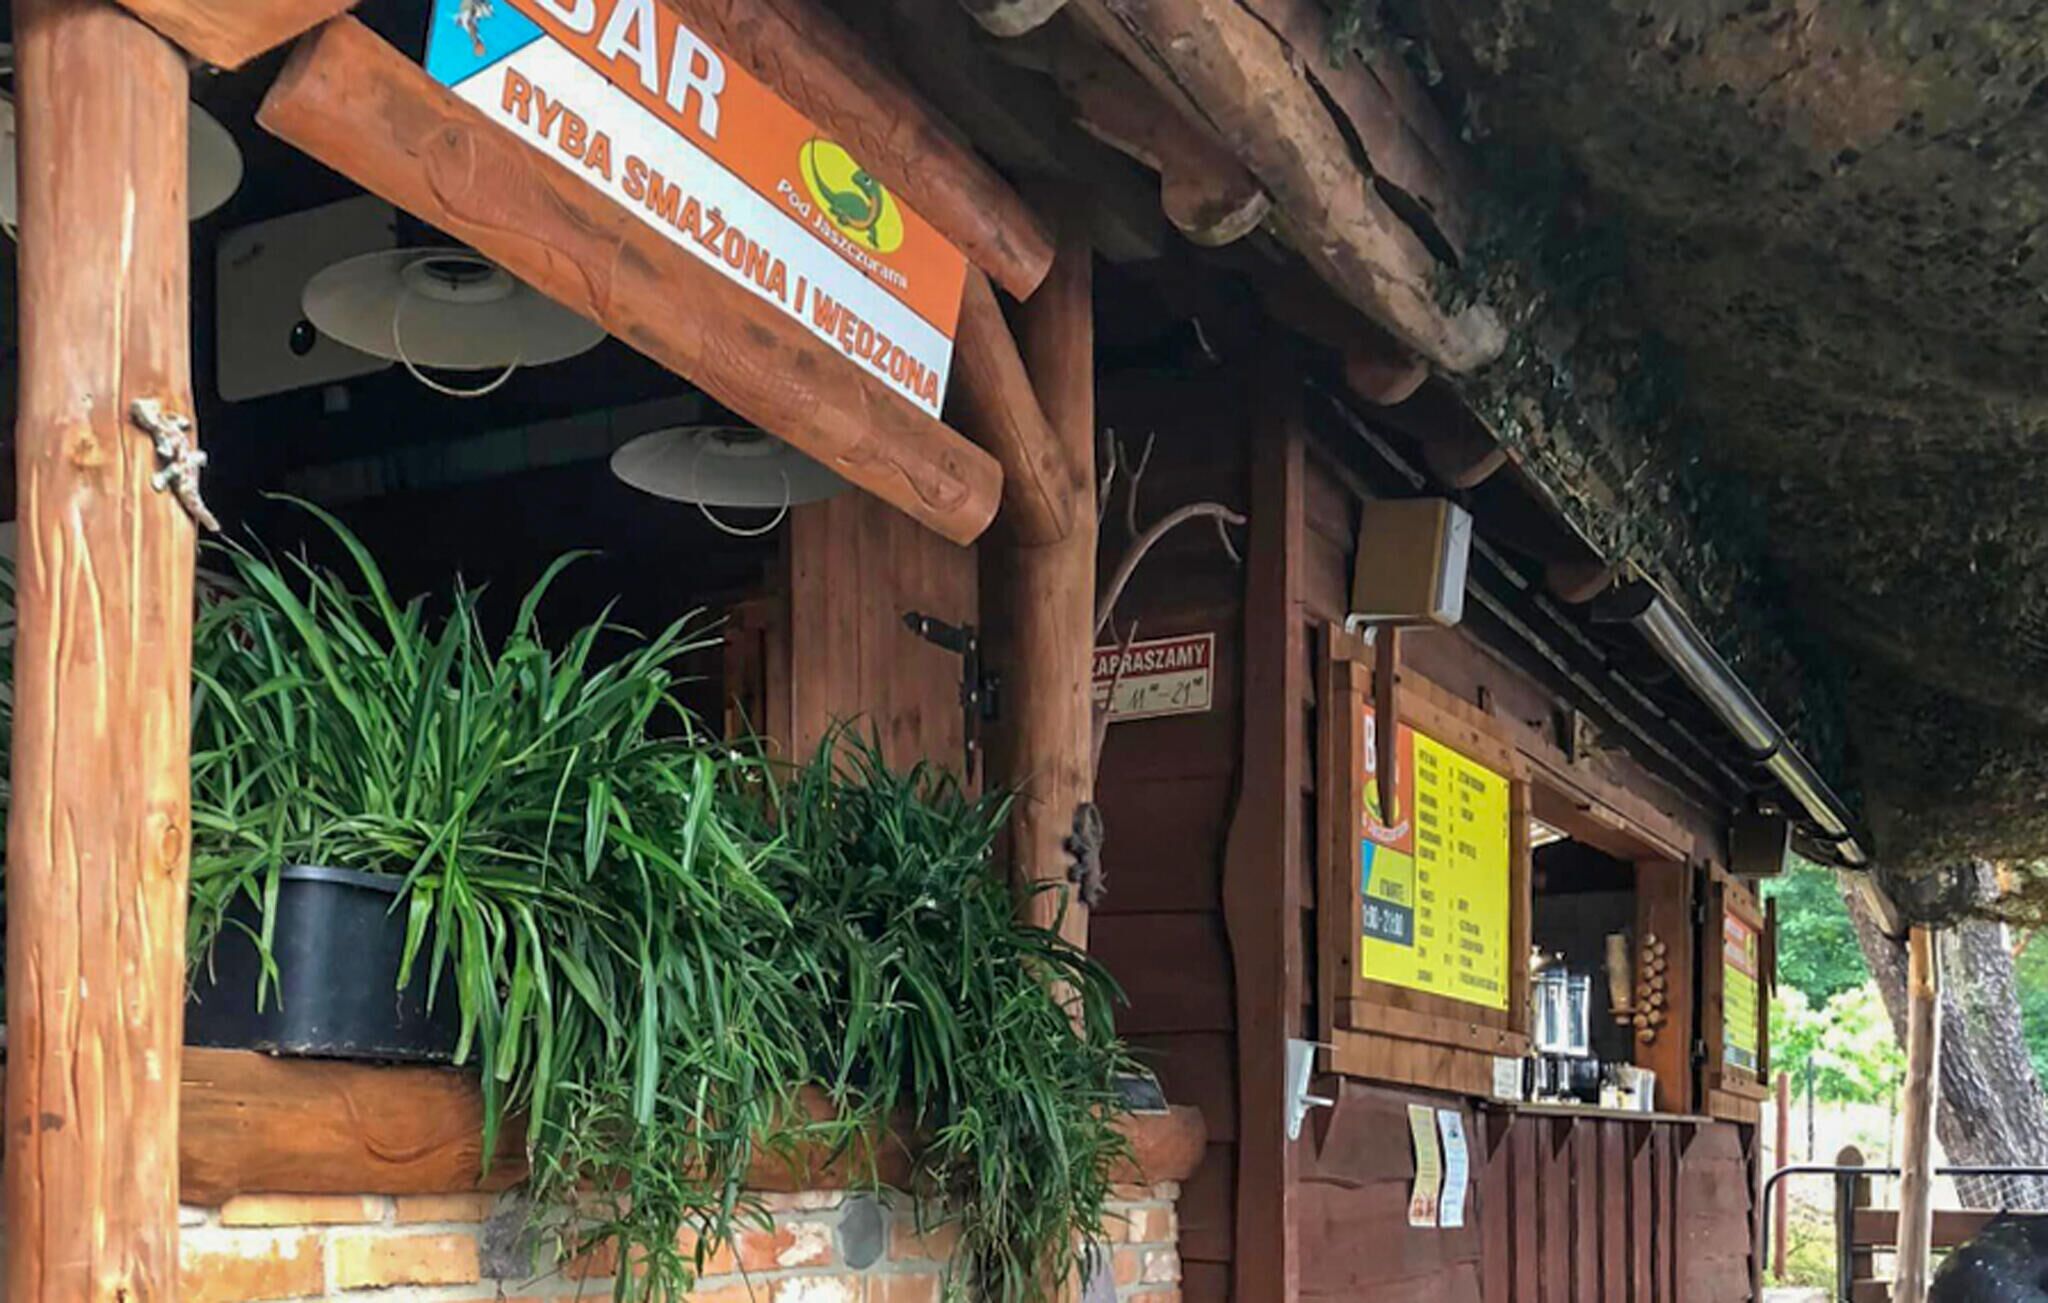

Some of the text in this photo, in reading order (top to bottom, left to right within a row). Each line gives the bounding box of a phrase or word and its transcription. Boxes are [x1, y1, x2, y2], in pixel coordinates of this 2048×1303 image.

[502, 67, 939, 408] RYBA SMAŻONA I WĘDZONA
[777, 178, 908, 289] Pod Jaszczurami
